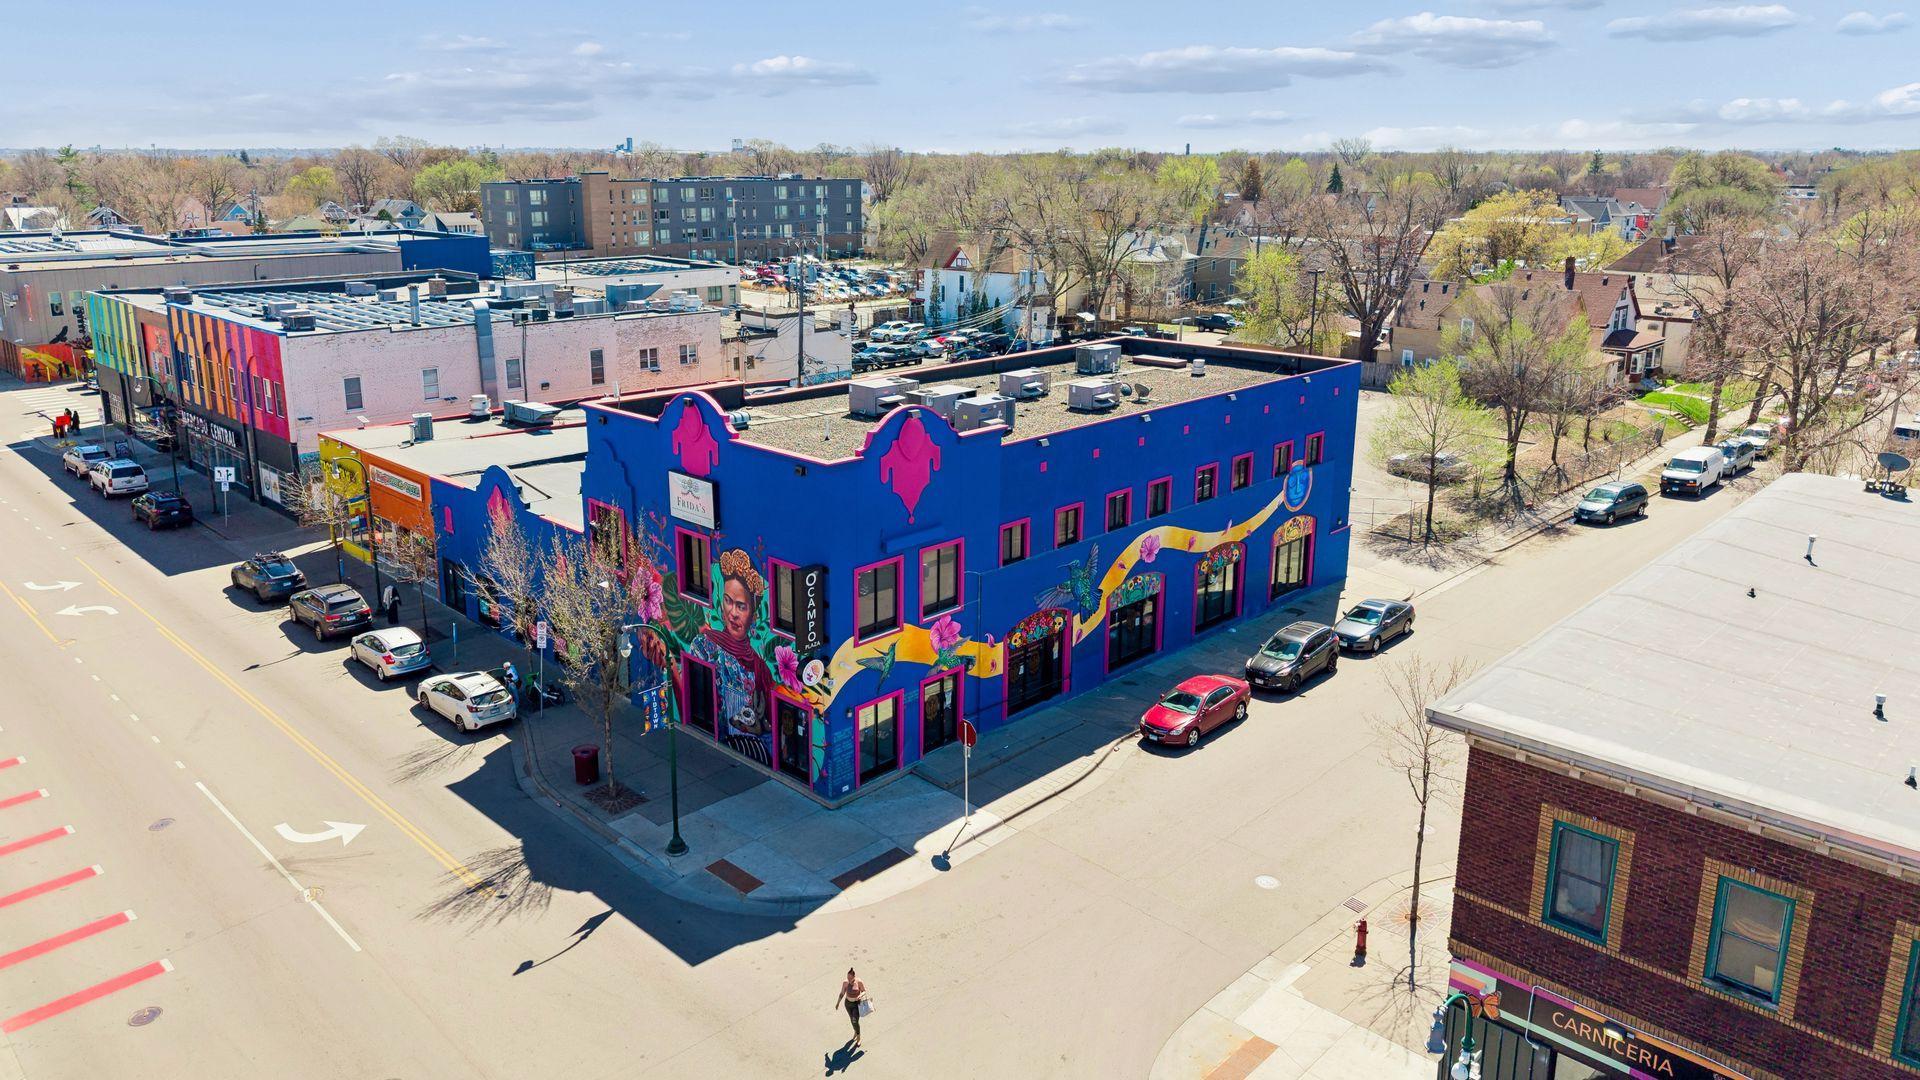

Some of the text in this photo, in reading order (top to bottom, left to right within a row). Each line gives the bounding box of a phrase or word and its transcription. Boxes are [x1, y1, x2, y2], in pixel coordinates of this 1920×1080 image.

[210, 422, 237, 448] CENTRAL
[676, 496, 706, 514] FRIDA'S
[805, 572, 818, 642] OCAMPO
[804, 640, 821, 651] PLAZA
[651, 690, 659, 729] MIDTOWN
[1552, 1011, 1674, 1077] CARNICERIA
